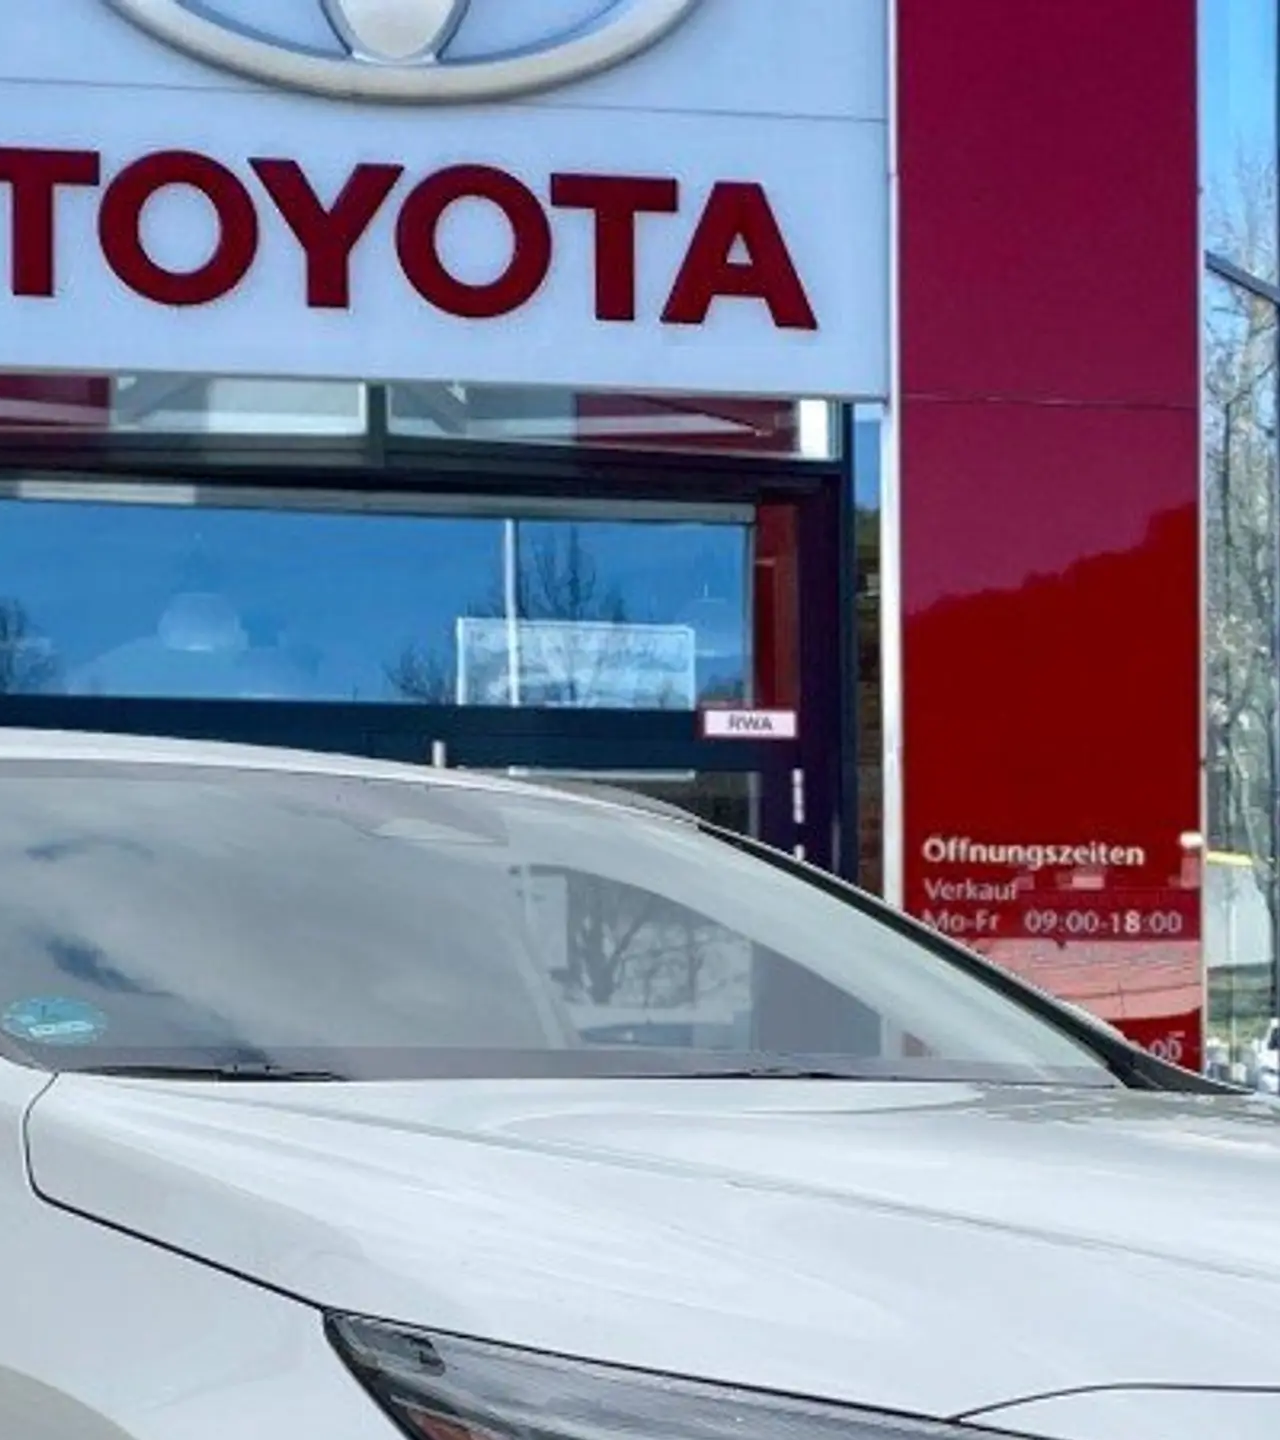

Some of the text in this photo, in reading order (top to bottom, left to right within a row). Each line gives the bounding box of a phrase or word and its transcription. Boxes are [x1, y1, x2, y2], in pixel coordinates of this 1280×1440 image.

[923, 877, 1020, 901] Verkauf
[921, 908, 1183, 934] Mo-Fr 09:00-18:00
